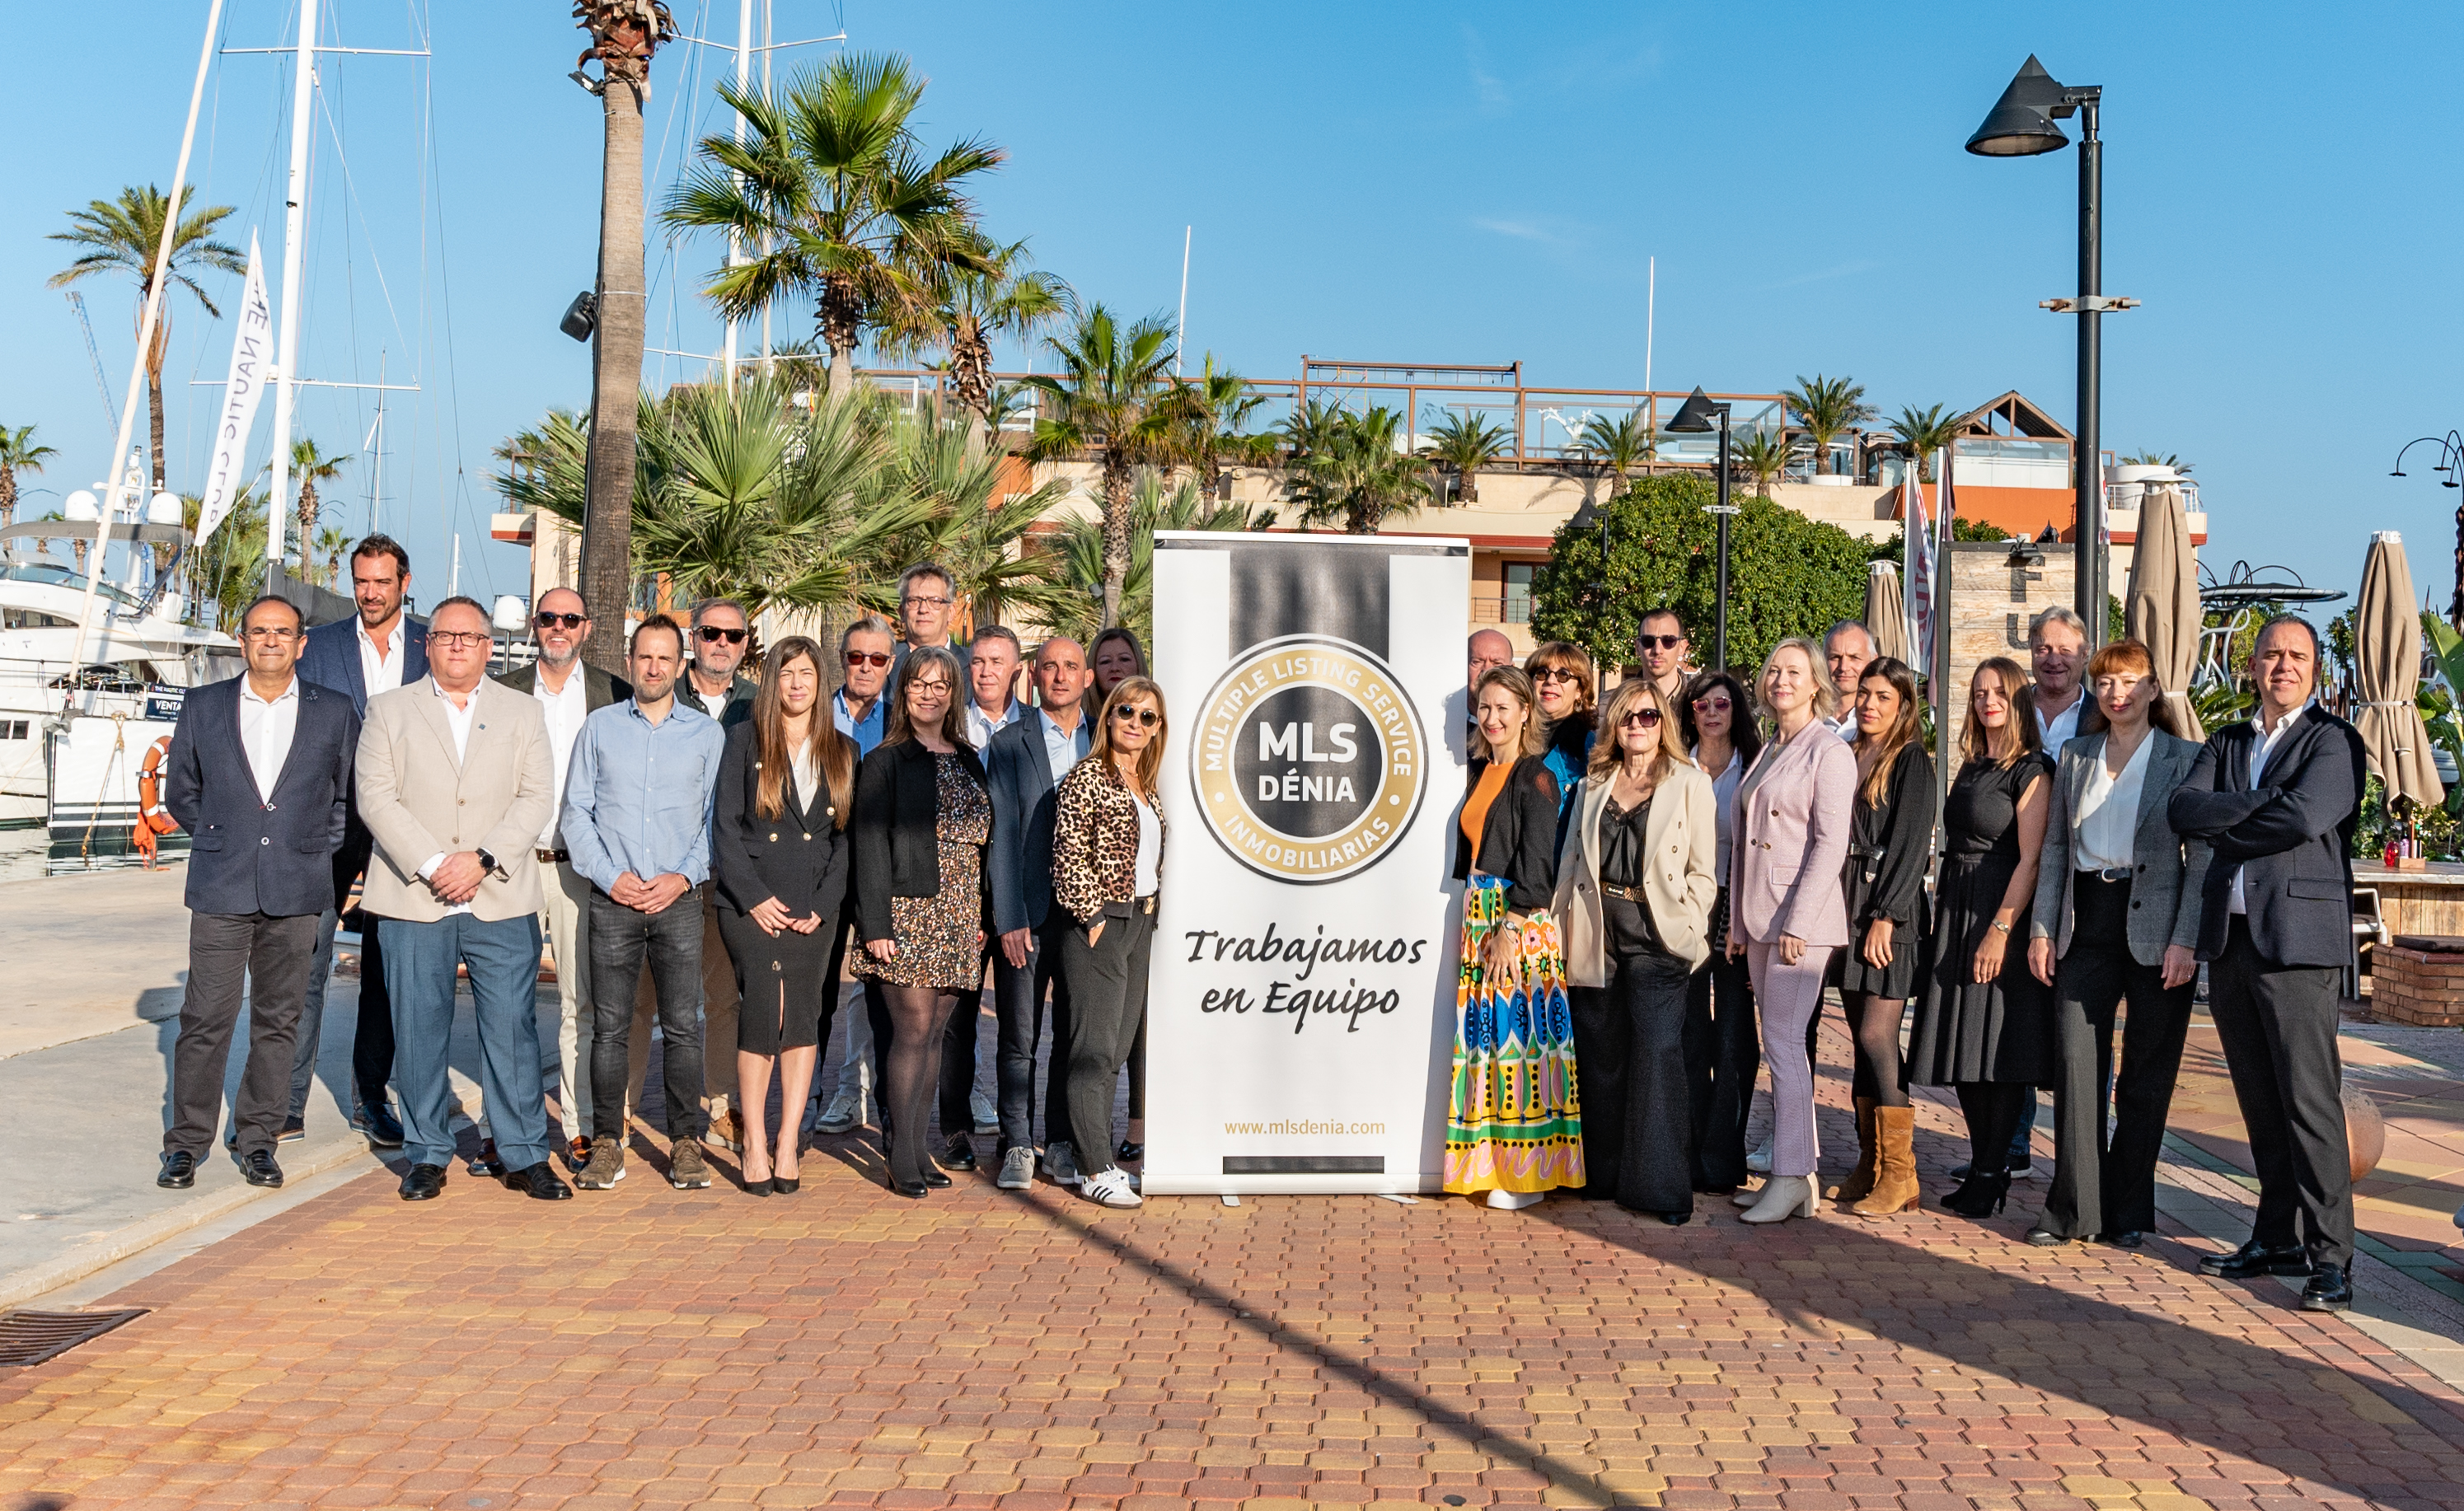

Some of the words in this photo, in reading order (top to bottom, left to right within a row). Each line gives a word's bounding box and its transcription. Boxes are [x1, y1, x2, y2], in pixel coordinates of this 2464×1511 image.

[156, 699, 182, 711] VENTA
[1206, 669, 1268, 770] MULTIPLE
[1272, 657, 1361, 688] LISTING
[1362, 683, 1412, 777] SERVICE
[1258, 721, 1358, 763] MLS
[1258, 767, 1356, 802] DÉNIA
[1225, 815, 1390, 869] INMOBILIARIAS
[1185, 922, 1427, 981] Trabajamos
[1201, 987, 1255, 1014] en
[1262, 978, 1400, 1035] Equipo
[1225, 1119, 1385, 1135] www.mlsdenia.com
